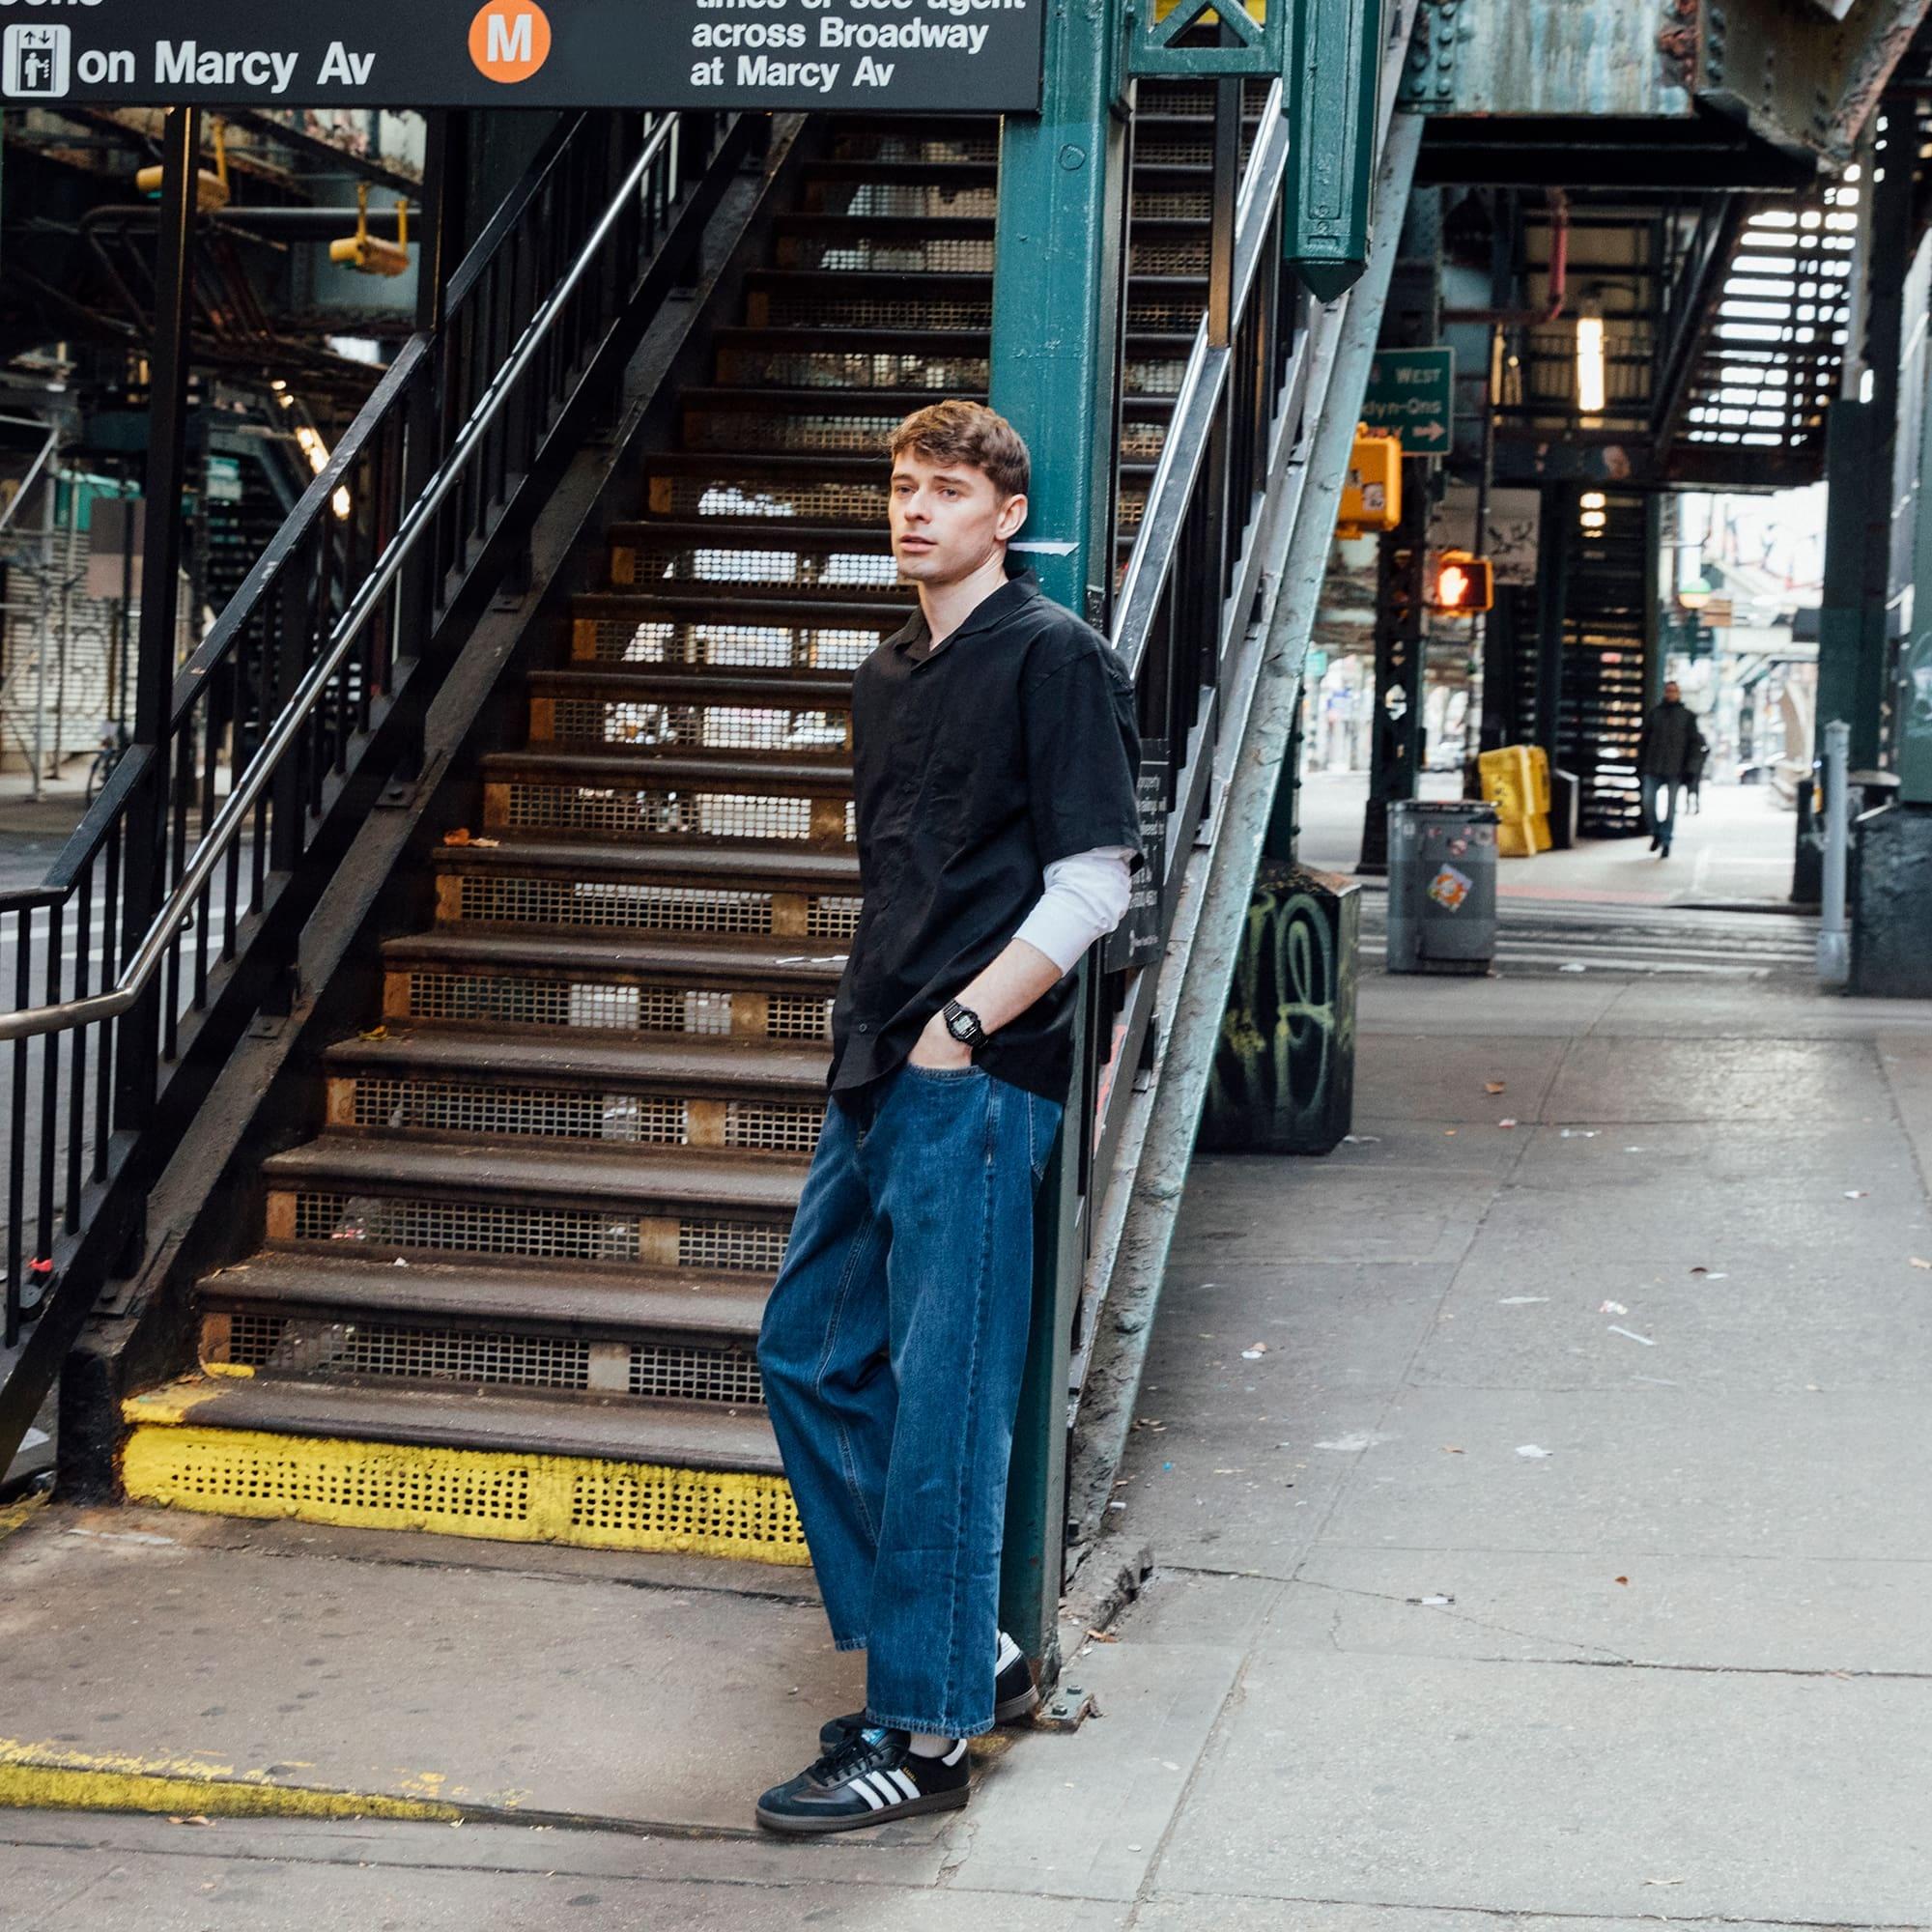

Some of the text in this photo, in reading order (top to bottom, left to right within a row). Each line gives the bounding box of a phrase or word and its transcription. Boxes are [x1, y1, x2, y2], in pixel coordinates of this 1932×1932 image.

[486, 14, 532, 63] M
[691, 15, 990, 55] across Broadway
[77, 40, 376, 94] on Marcy Av
[690, 54, 895, 94] at Marcy Av
[1395, 367, 1442, 384] WEST
